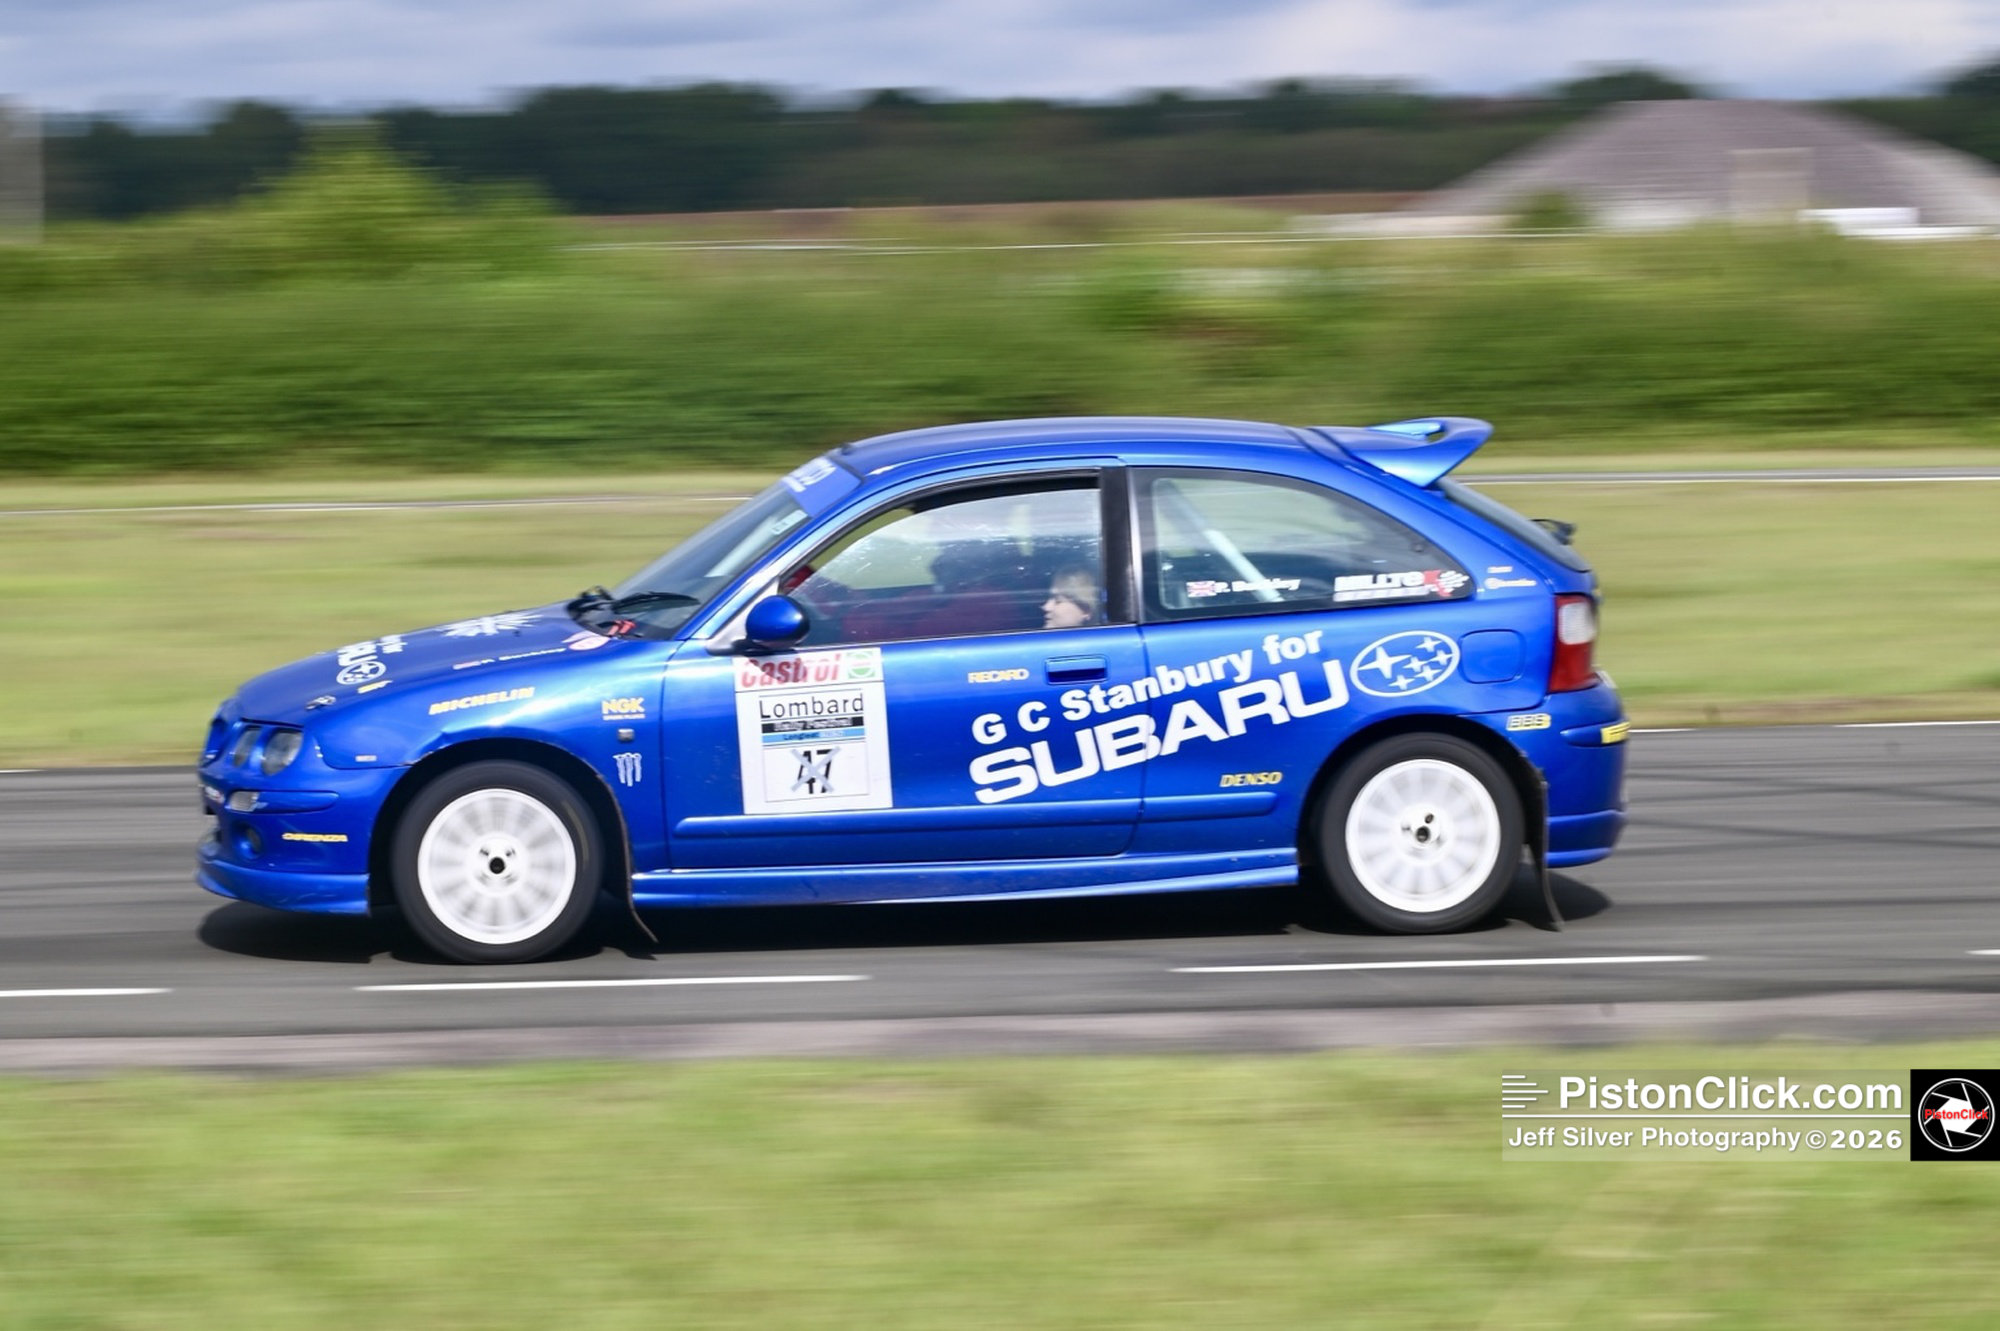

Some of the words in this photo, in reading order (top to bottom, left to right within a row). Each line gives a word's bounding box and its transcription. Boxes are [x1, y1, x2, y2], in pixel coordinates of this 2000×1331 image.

[967, 669, 1029, 683] RECARO
[972, 713, 1007, 745] G
[1017, 701, 1050, 732] C
[1060, 649, 1253, 721] Stanbury
[1262, 630, 1323, 665] for
[428, 686, 536, 715] MICHELIN
[602, 697, 645, 714] NGK
[759, 693, 864, 719] Lombard
[969, 659, 1349, 804] SUBARU
[1219, 771, 1283, 787] DENSO
